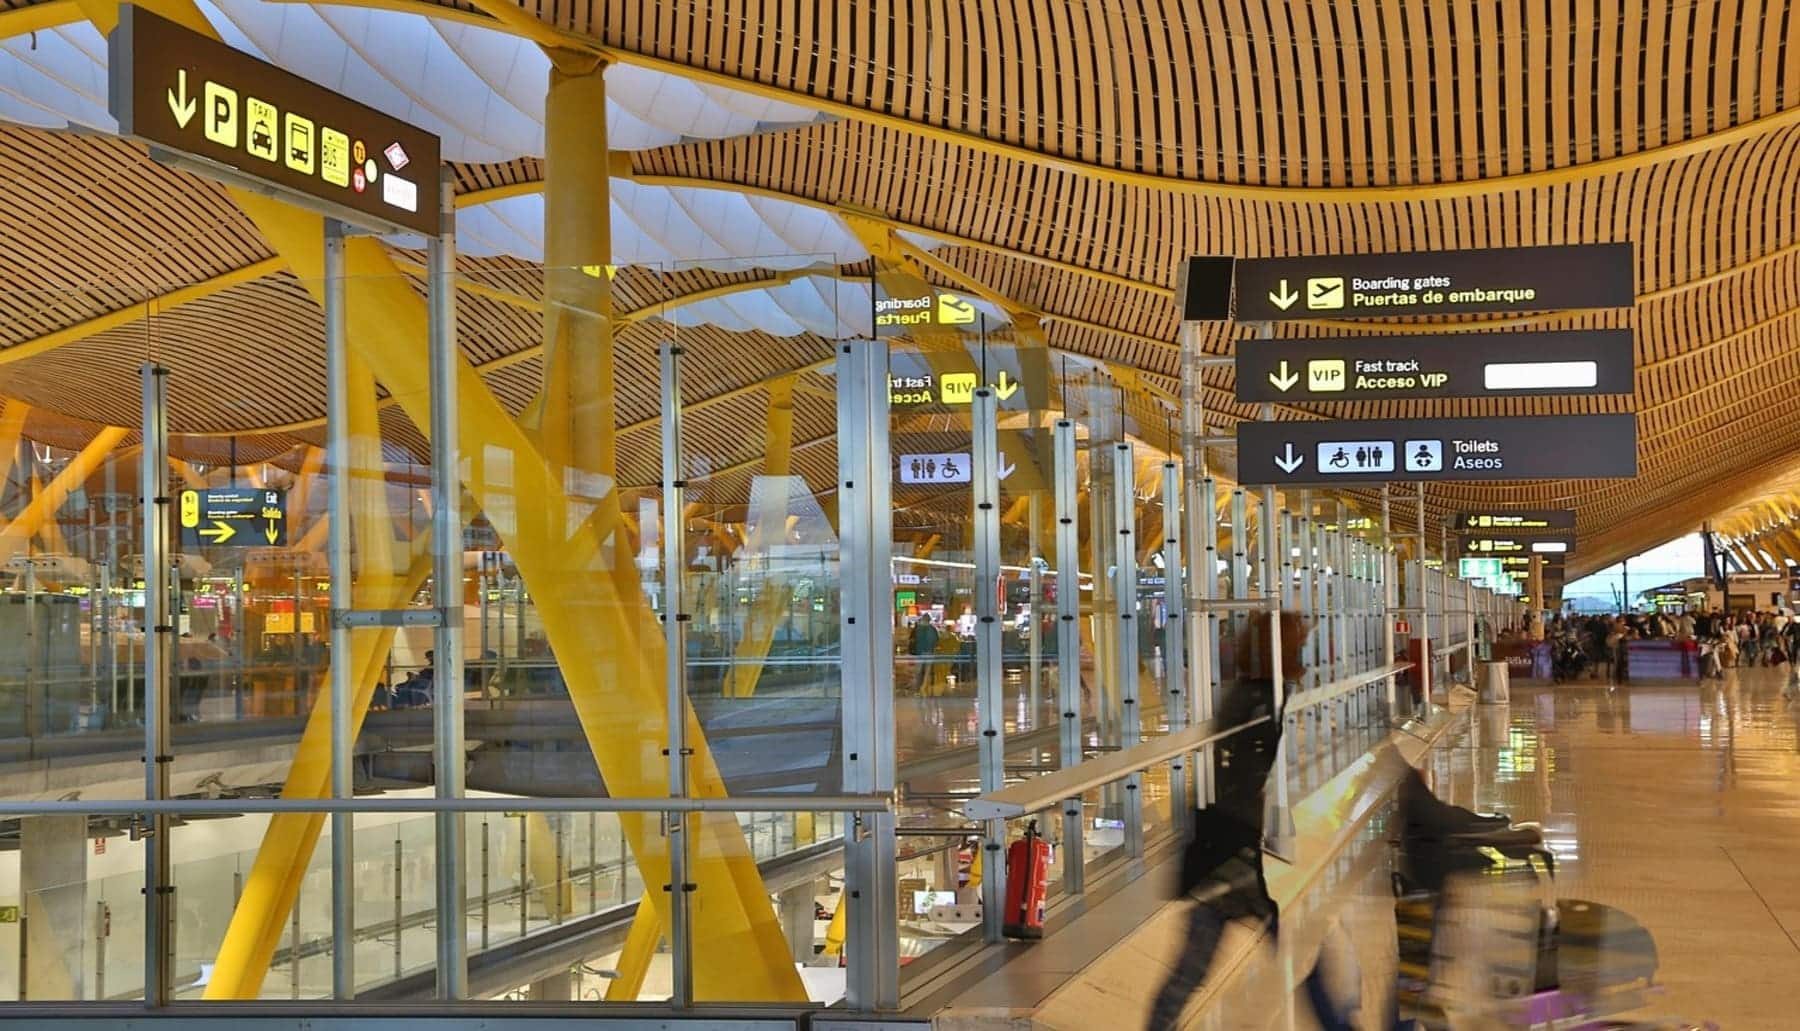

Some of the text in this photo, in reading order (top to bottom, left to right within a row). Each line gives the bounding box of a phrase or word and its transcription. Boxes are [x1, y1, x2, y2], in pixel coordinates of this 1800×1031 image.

[214, 94, 230, 133] P
[253, 102, 272, 119] TAXI
[1352, 275, 1450, 291] Boarding gates
[1353, 288, 1535, 306] Puertas de embarque
[1355, 360, 1419, 373] Fast track
[1313, 369, 1340, 381] VIP
[1355, 373, 1448, 389] Acceso VIP
[1452, 440, 1499, 453] Toilets
[1453, 455, 1503, 469] Aseos
